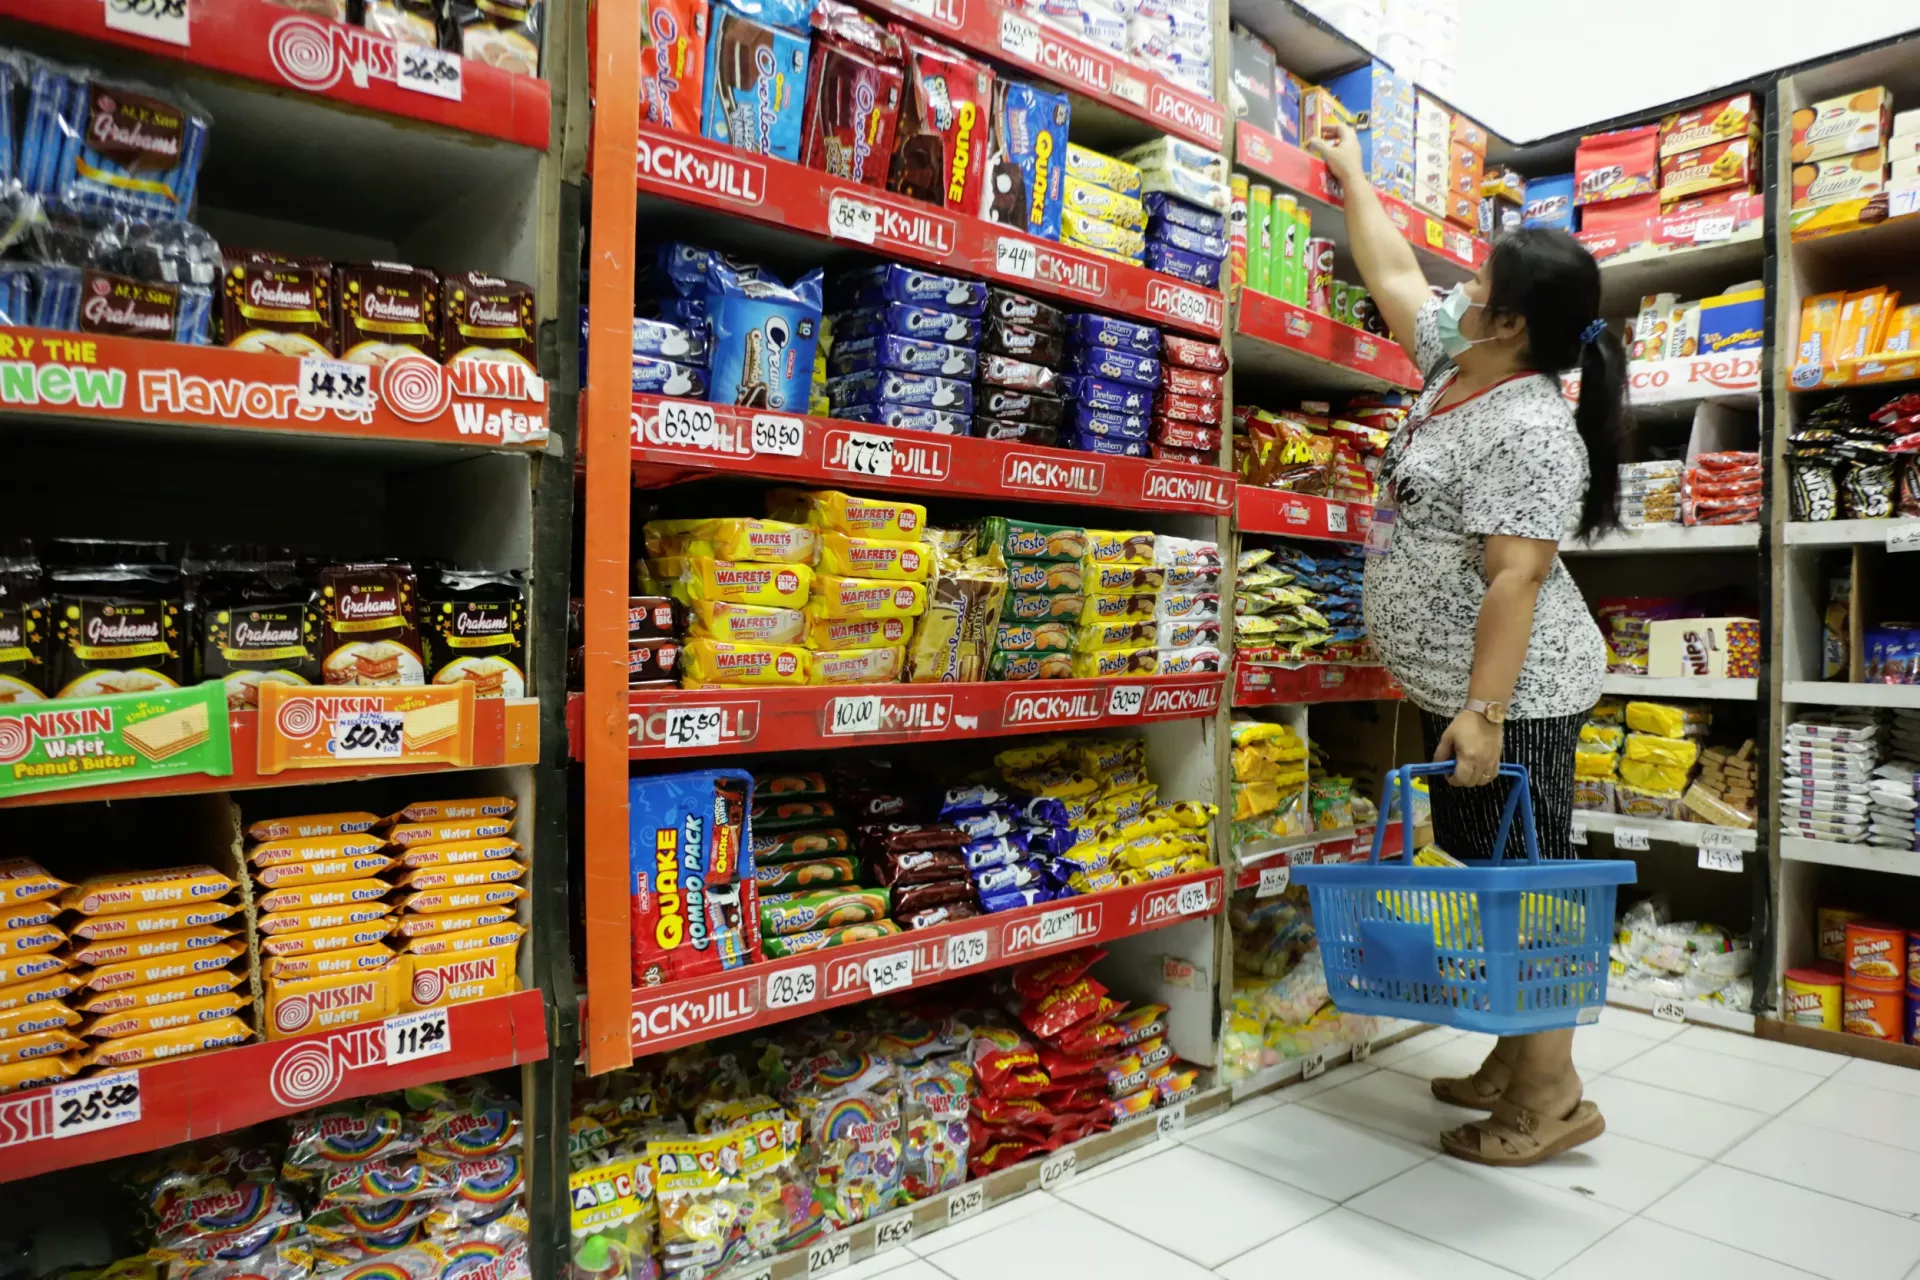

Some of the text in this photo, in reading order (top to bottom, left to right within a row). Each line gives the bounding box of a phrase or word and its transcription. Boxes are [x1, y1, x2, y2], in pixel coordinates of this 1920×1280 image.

[94, 113, 179, 155] Grahams
[948, 101, 976, 204] QUAKE
[636, 140, 757, 201] ACK'nJILL
[1030, 129, 1053, 226] QUAKE
[1581, 165, 1623, 194] NIPS
[1523, 196, 1568, 219] NIPS
[1165, 257, 1192, 273] Dewberry
[146, 290, 171, 305] San
[250, 278, 312, 306] Grahams
[84, 296, 172, 332] Grahams
[364, 294, 421, 319] Grahams
[469, 301, 518, 324] Grahams
[1103, 320, 1133, 338] Dewberry
[0, 334, 98, 364] RY THE
[1105, 351, 1136, 369] Dewberry
[308, 372, 366, 400] 14.75
[1793, 367, 1820, 384] NEW
[1093, 390, 1123, 405] Dewberry
[1172, 398, 1199, 413] Dewberry
[663, 408, 713, 442] 63.00
[1093, 410, 1123, 424] Dewberry
[755, 427, 800, 453] 58.50
[1169, 427, 1195, 440] Dewberry
[1094, 439, 1124, 453] Dewberry
[847, 508, 895, 521] WAFRETS
[899, 519, 916, 529] BIG
[750, 532, 791, 545] WAFRETS
[1008, 529, 1046, 555] Presto
[1092, 537, 1122, 563] Presto
[849, 549, 898, 561] WAFRETS
[902, 560, 918, 570] BIG
[716, 571, 772, 586] WAFRETS
[777, 574, 799, 584] EXTRA
[1012, 560, 1045, 587] Presto
[1101, 565, 1132, 588] Presto
[777, 581, 797, 592] BIG
[840, 588, 891, 605] WAFRETS
[340, 593, 397, 619] Grahams
[895, 596, 914, 605] BIG
[1015, 592, 1049, 616] Presto
[1098, 594, 1127, 617] Presto
[88, 616, 159, 645] Grahams
[235, 622, 298, 647] Grahams
[457, 611, 508, 635] Grahams
[730, 617, 778, 631] WAFRETS
[830, 620, 880, 641] WAFRETS
[1103, 623, 1131, 642] Presto
[999, 625, 1032, 650] Presto
[716, 653, 772, 669] WAFRETS
[1099, 653, 1127, 676] Presto
[1683, 631, 1709, 675] NIPS
[778, 663, 795, 673] BIG
[823, 658, 869, 675] WAFRETS
[1005, 656, 1038, 680] Presto
[24, 707, 114, 738] NISSIN
[836, 700, 873, 729] 10.00
[340, 722, 403, 751] 50.75
[669, 711, 721, 746] 45.50
[44, 738, 105, 759] Wafer
[14, 754, 137, 779] Peanut Butter
[445, 806, 475, 817] Wafer
[481, 804, 511, 815] Cheese
[299, 825, 333, 837] Wafer
[340, 822, 373, 832] Cheese
[440, 827, 470, 839] Wafer
[476, 826, 507, 836] Cheese
[301, 844, 377, 861] Wafer Cheese
[446, 850, 477, 862] Wafer
[484, 846, 514, 858] Cheese
[716, 826, 731, 875] QUAKE
[140, 882, 229, 903] Wafer Cheese
[655, 828, 683, 950] QUAKE
[683, 814, 709, 951] COMBO PACK
[186, 911, 228, 926] Cheese
[772, 906, 815, 936] Presto
[952, 938, 985, 966] 13.75
[440, 957, 497, 986] NISSIN
[309, 982, 376, 1011] NISSIN
[449, 983, 485, 1000] Wafer
[771, 973, 815, 1004] 28.25
[198, 1006, 237, 1022] Cheese
[318, 1008, 360, 1026] Wafer
[632, 987, 752, 1039] ACK'nJILL
[17, 1016, 67, 1034] Cheese
[59, 1083, 140, 1128] 25.50
[660, 1152, 716, 1175] ABC
[574, 1175, 632, 1211] ABC
[666, 1176, 704, 1190] JELLY
[581, 1207, 624, 1226] JELLY
